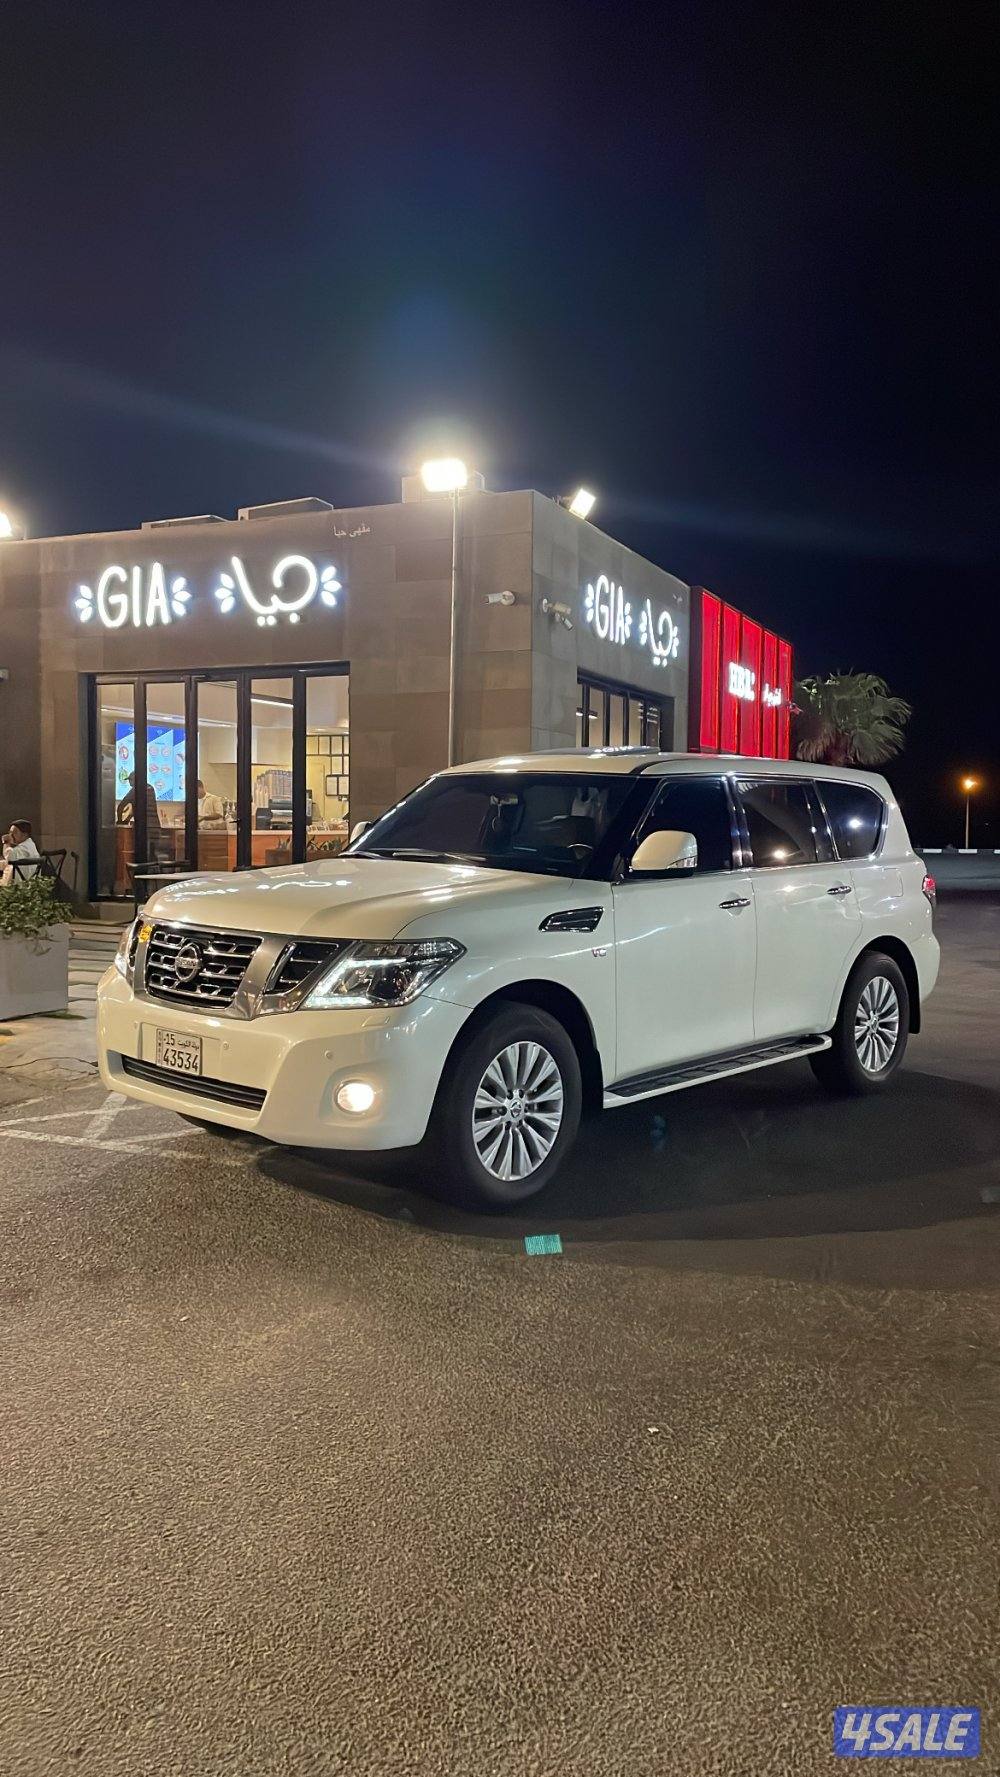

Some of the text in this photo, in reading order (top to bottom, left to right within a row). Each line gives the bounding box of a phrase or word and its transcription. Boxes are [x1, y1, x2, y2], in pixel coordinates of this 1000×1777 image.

[97, 562, 171, 628] GIA
[231, 555, 318, 627] جيا
[595, 574, 626, 646] GIA
[646, 598, 673, 668] جيا
[163, 1048, 199, 1072] 43534
[165, 1033, 175, 1046] 15
